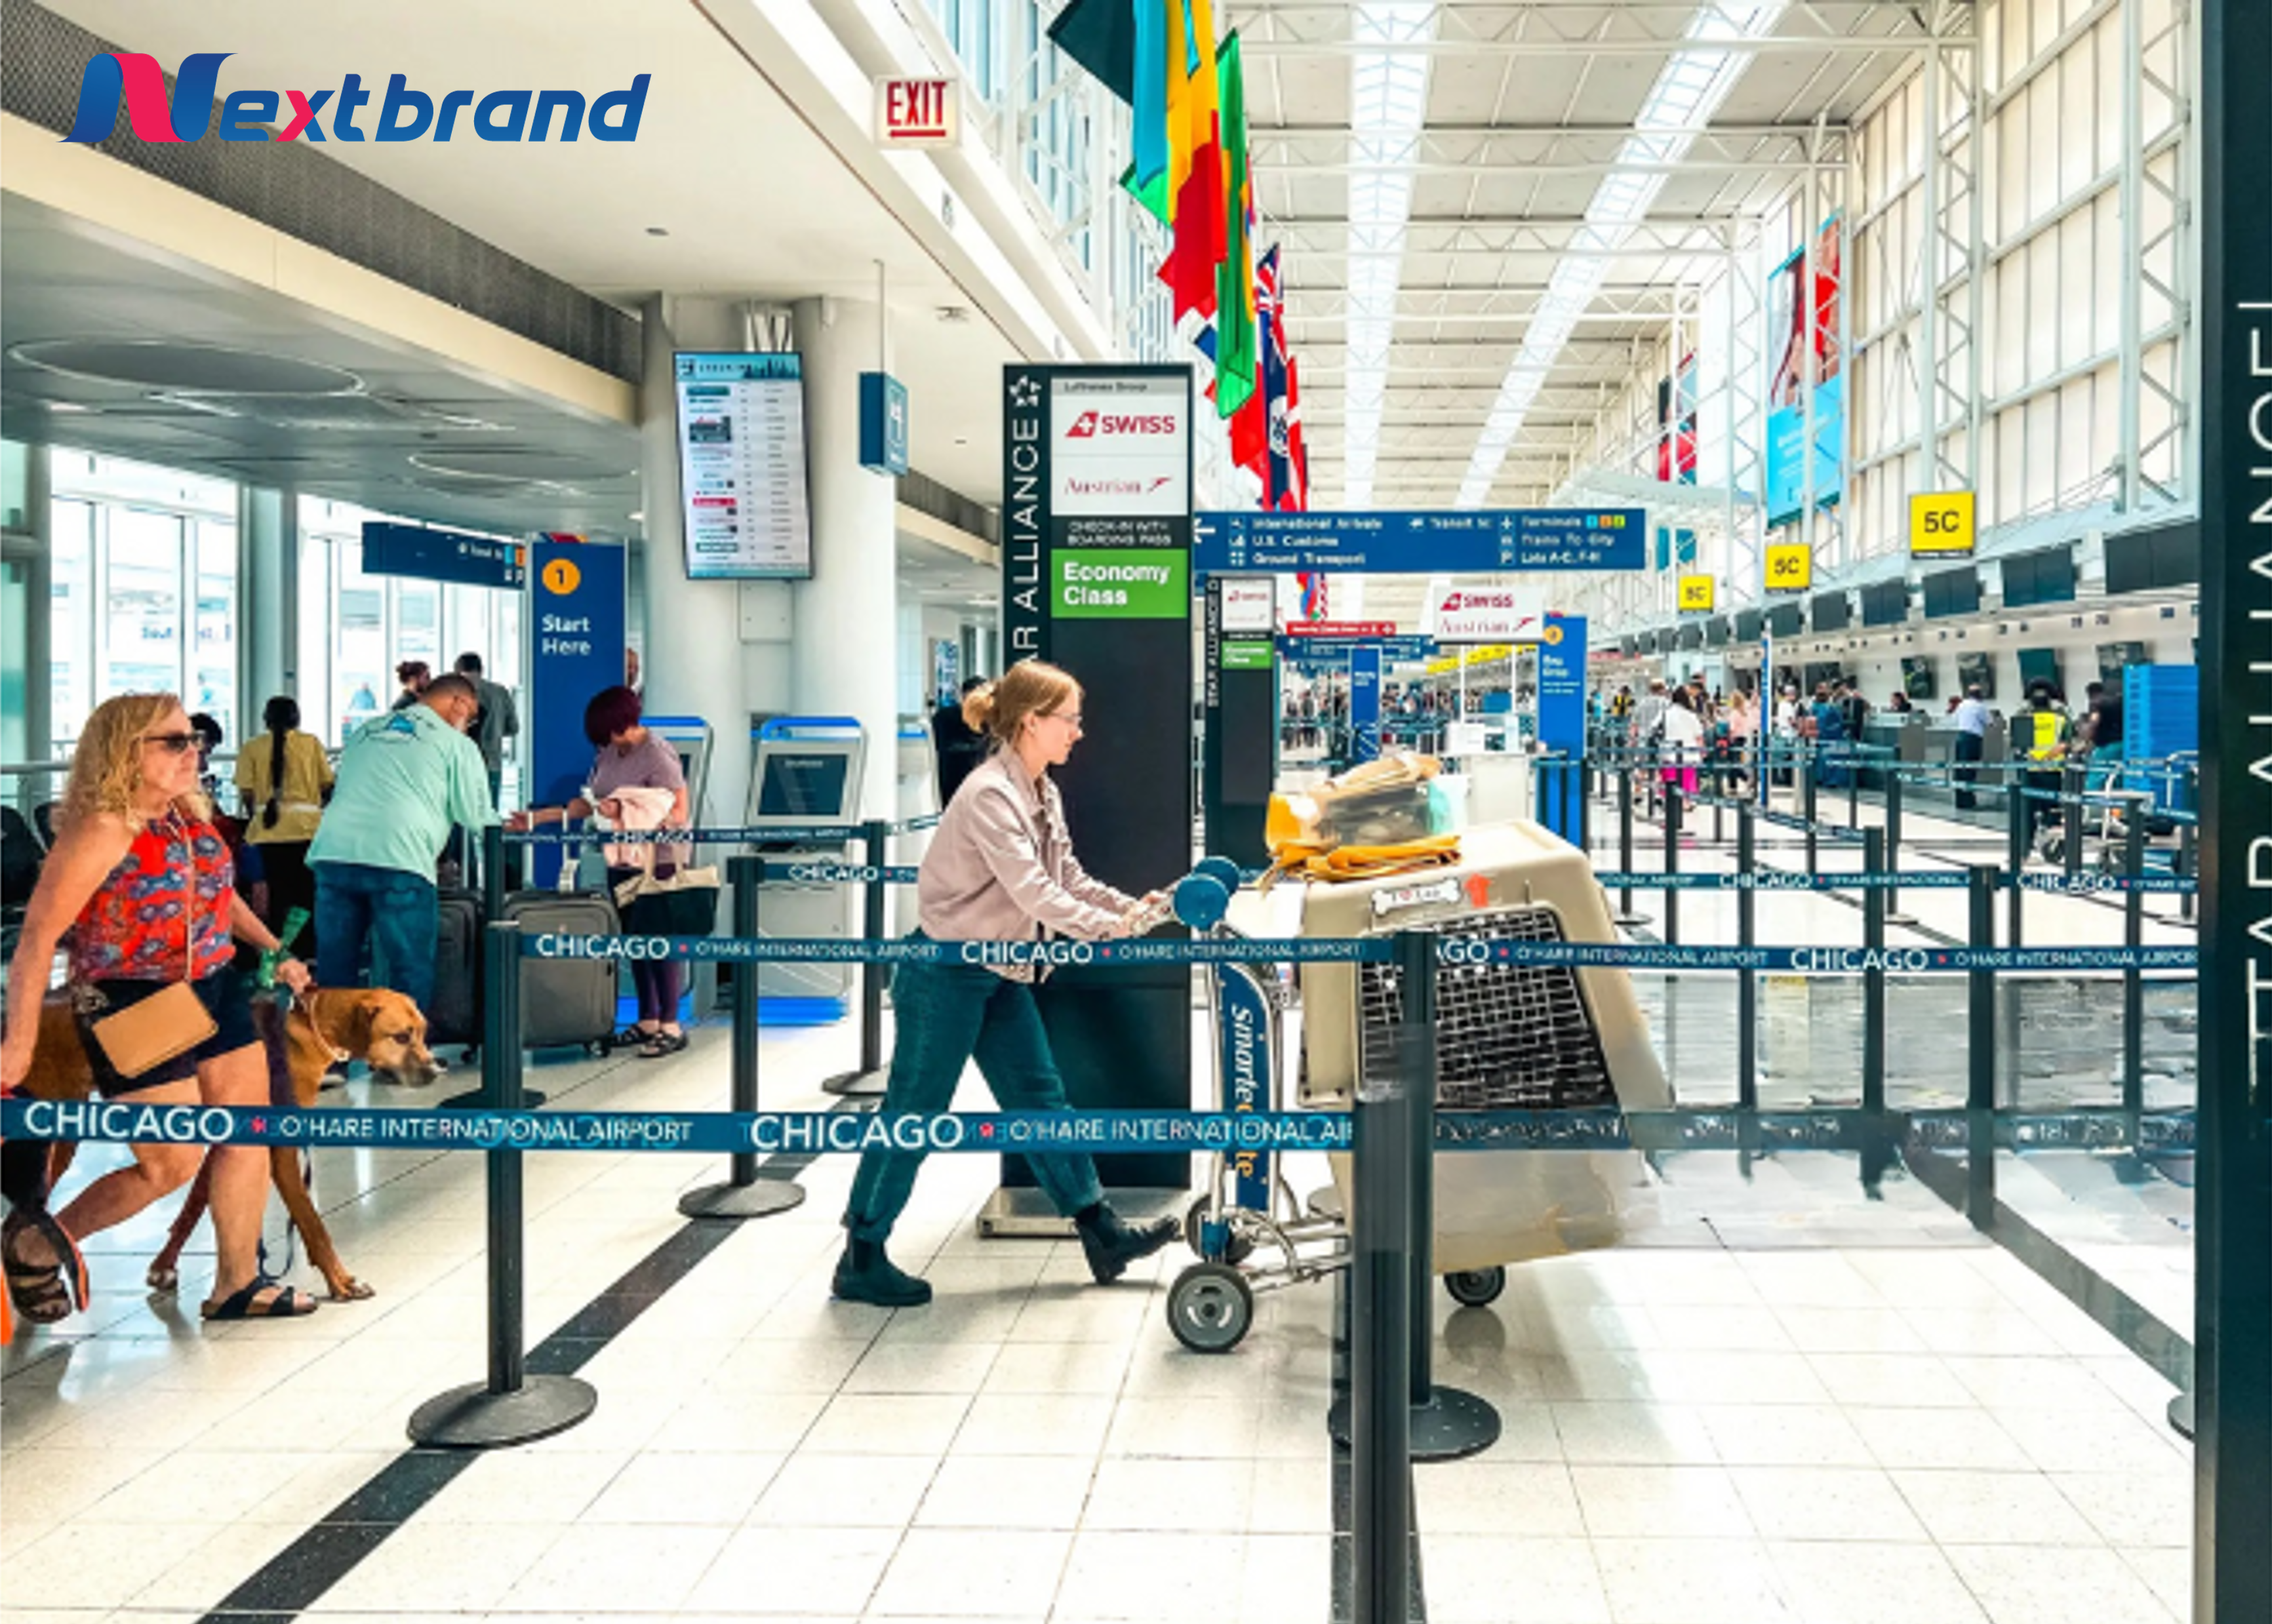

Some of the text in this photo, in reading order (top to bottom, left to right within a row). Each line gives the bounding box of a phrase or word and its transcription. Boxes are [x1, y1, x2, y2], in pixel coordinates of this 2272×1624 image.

[887, 81, 947, 126] EXIT
[1102, 416, 1175, 434] SWISS
[1064, 477, 1142, 494] Austrian
[1013, 418, 1039, 612] ALLIANCE
[1924, 510, 1959, 533] 5C
[1064, 561, 1171, 584] Economy
[1774, 557, 1800, 575] 5C
[1064, 585, 1127, 604] Class
[542, 614, 590, 633] Start
[542, 637, 591, 654] Here
[788, 865, 878, 882] CHICAGO
[1719, 874, 1812, 888] CHICAGO
[536, 934, 669, 959] CHICAGO
[961, 941, 1094, 964] CHICAGO
[1790, 947, 1930, 972] CHICAGO
[2142, 949, 2198, 965] AIRPOR
[24, 1102, 692, 1143] CHICAGO O'HARE INTERNATIONAL AIRPORT
[750, 1115, 965, 1149] CHICAGO
[1009, 1119, 1106, 1141] O'HARE
[1113, 1119, 1317, 1141] INTERNATIONAL
